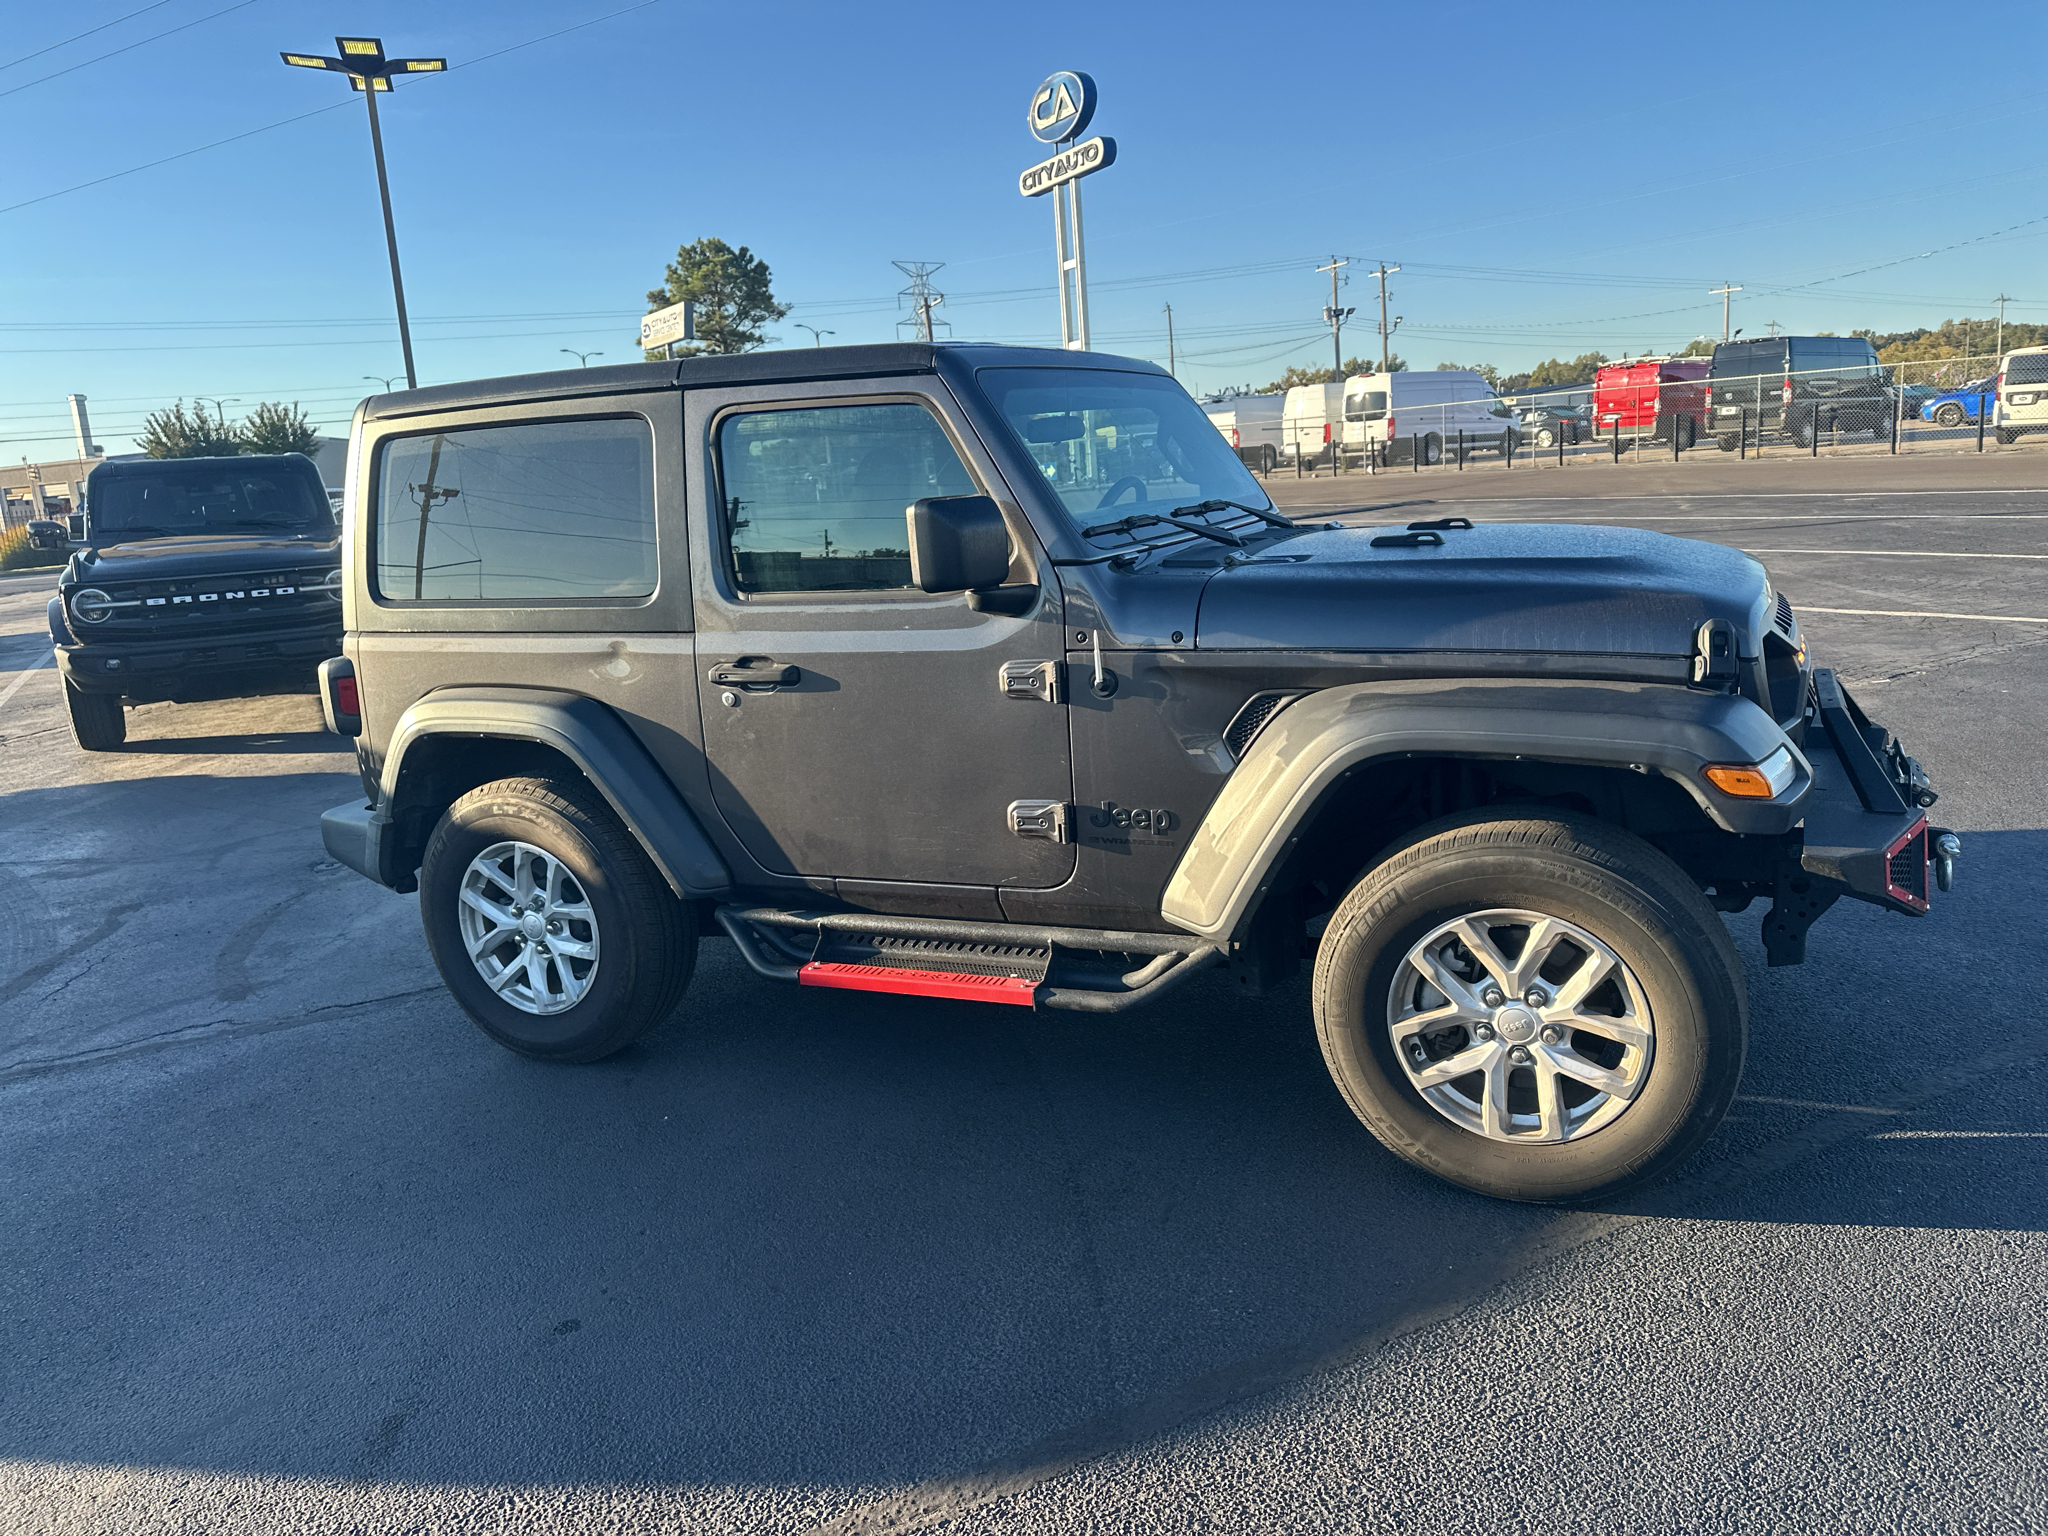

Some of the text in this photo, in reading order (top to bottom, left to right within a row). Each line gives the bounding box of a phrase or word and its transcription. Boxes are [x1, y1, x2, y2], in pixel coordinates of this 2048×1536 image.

[1033, 82, 1078, 130] CA
[146, 586, 295, 606] BRONCO
[1089, 801, 1171, 836] Jeep
[1101, 836, 1176, 848] WRANGLER
